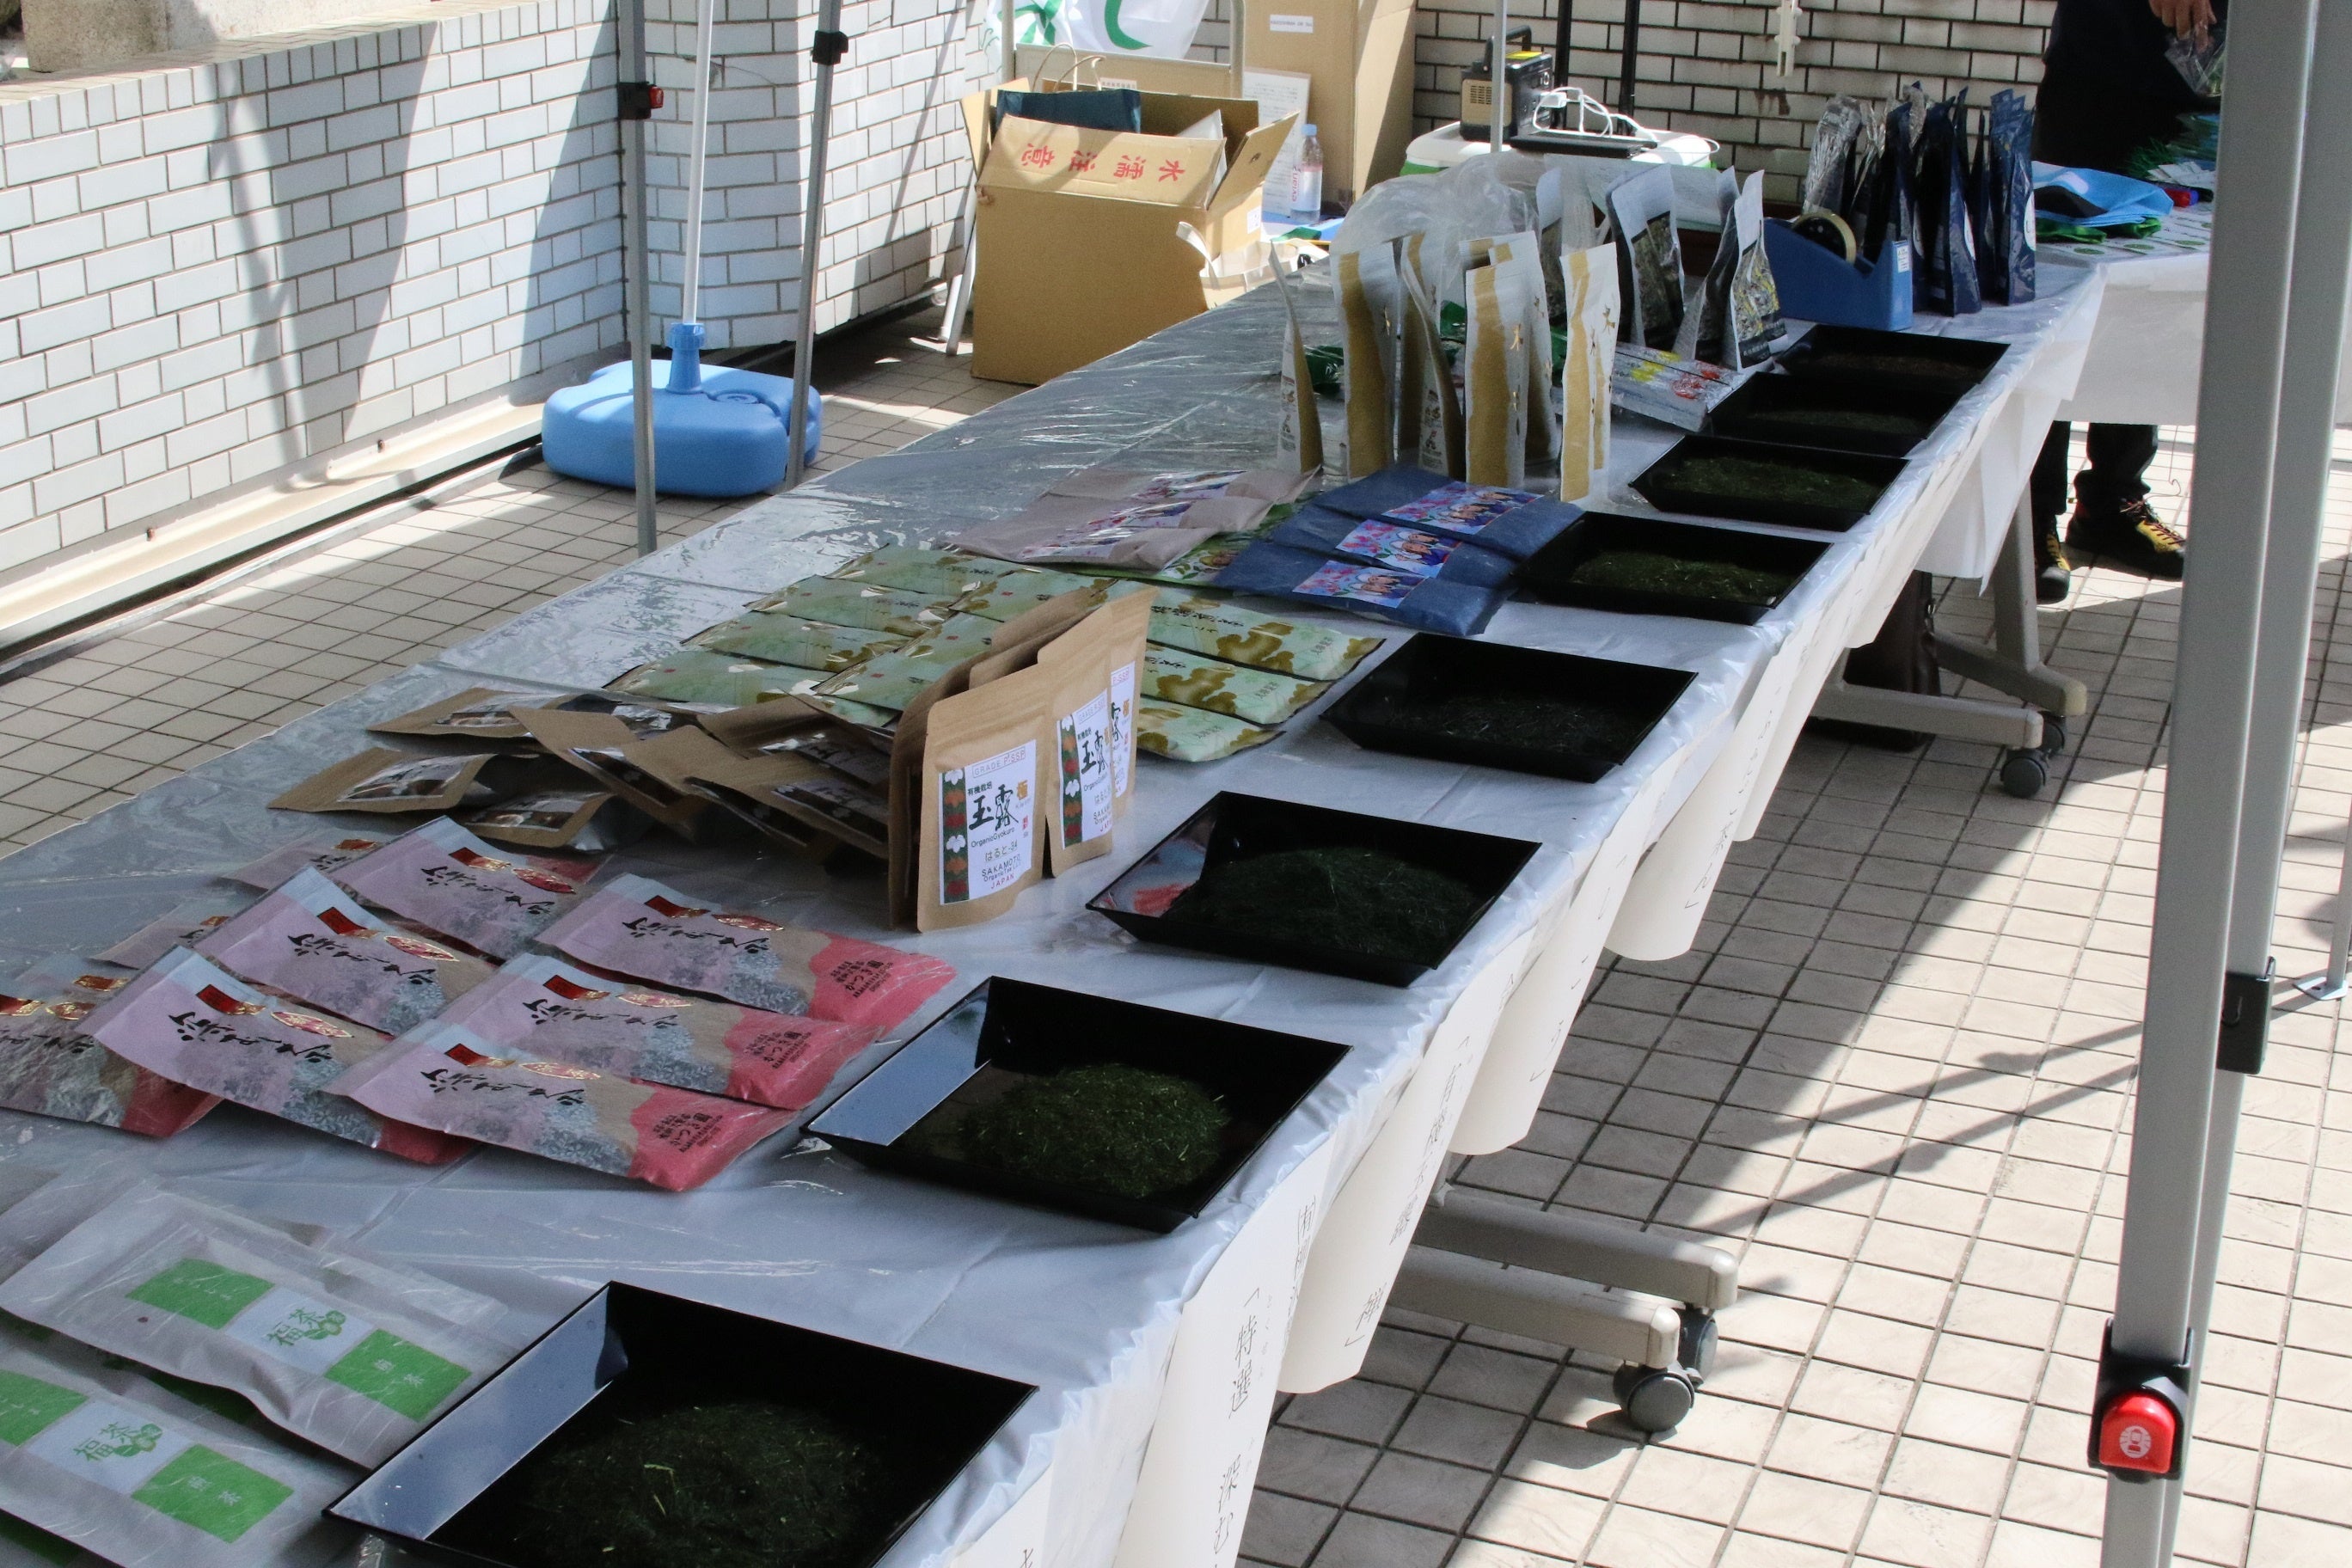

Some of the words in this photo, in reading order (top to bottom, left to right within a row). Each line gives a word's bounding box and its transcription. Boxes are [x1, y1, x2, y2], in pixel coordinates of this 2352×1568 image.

[1021, 142, 1185, 183] 水濡注意
[974, 759, 1001, 775] GRADE
[968, 781, 992, 796] 有機栽培
[969, 784, 1020, 831] 玉露
[982, 853, 1020, 877] SAKAMOTO
[990, 873, 1014, 889] JAPAN
[266, 1307, 325, 1347] 福茶
[73, 1421, 142, 1461] 福茶
[1214, 1454, 1241, 1568] 深む
